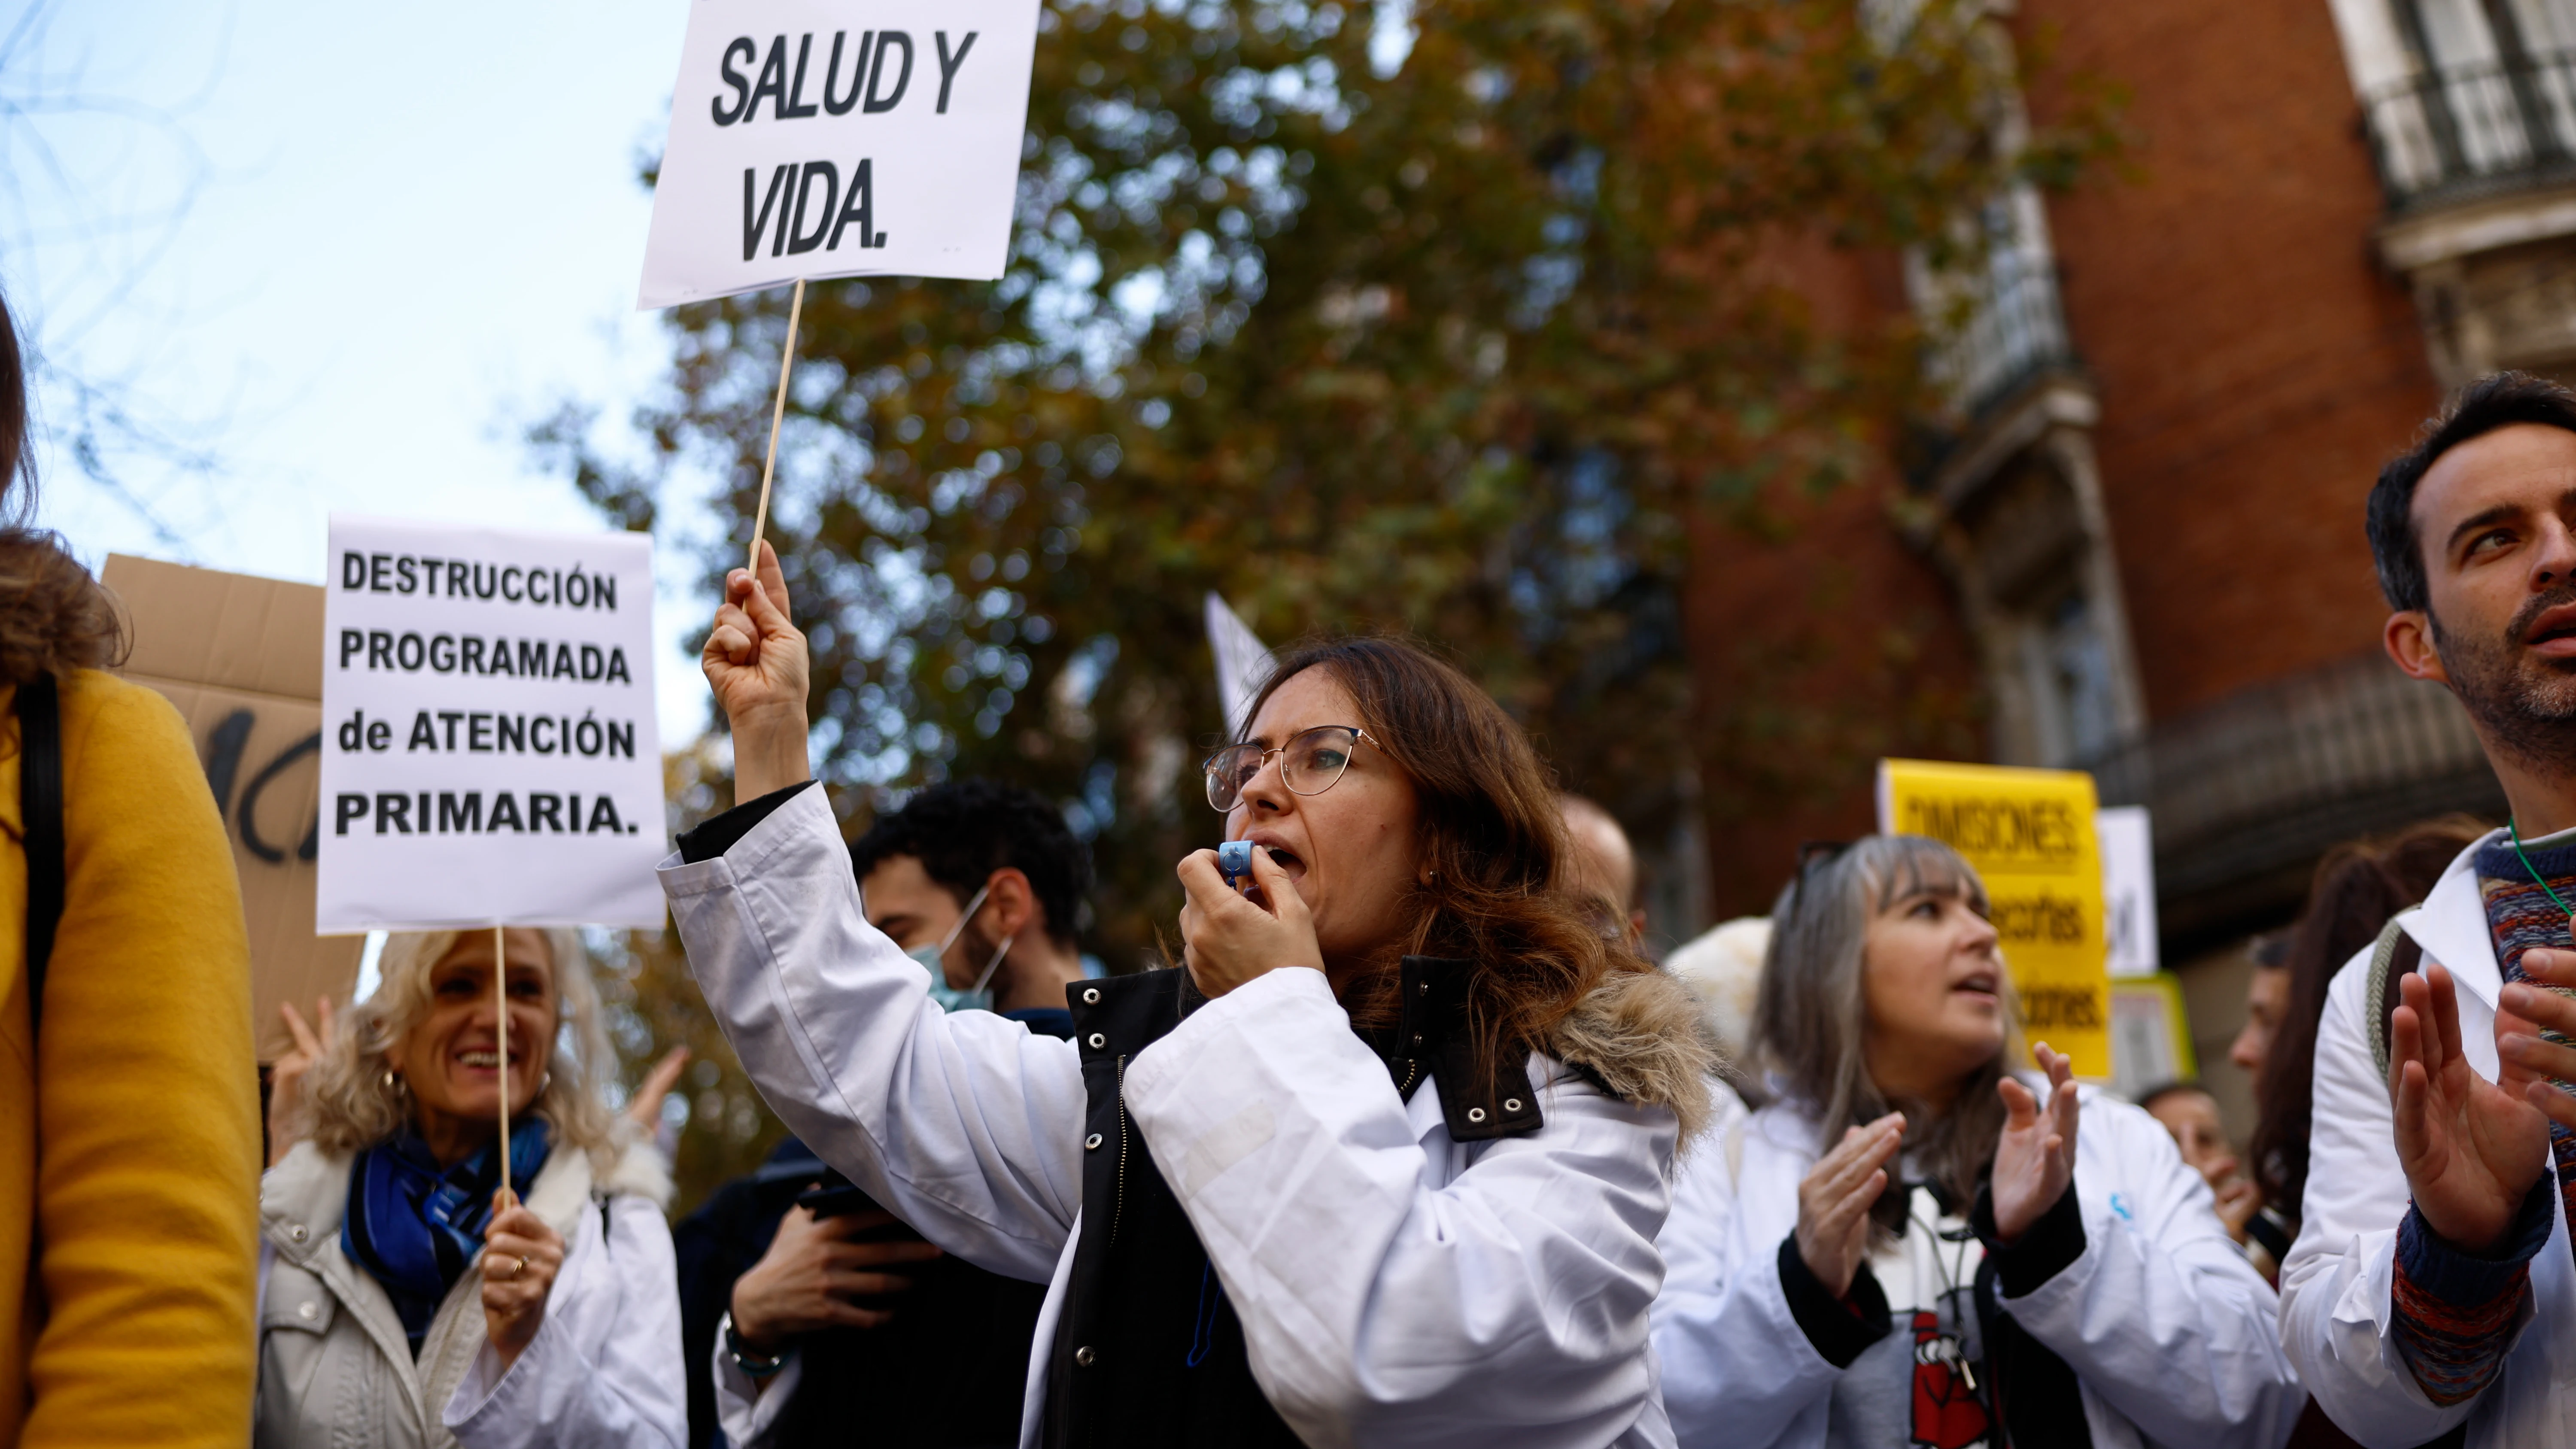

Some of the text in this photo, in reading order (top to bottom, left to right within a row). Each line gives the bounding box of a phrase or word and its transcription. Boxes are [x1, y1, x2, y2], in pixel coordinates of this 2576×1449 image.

[711, 30, 978, 127] SALUD Y
[743, 158, 888, 262] VIDA.
[342, 550, 617, 612] DESTRUCCIÓN
[339, 628, 632, 686] PROGRAMADA
[338, 707, 636, 760] de ATENCIÓN
[334, 790, 639, 838] PRIMARIA.
